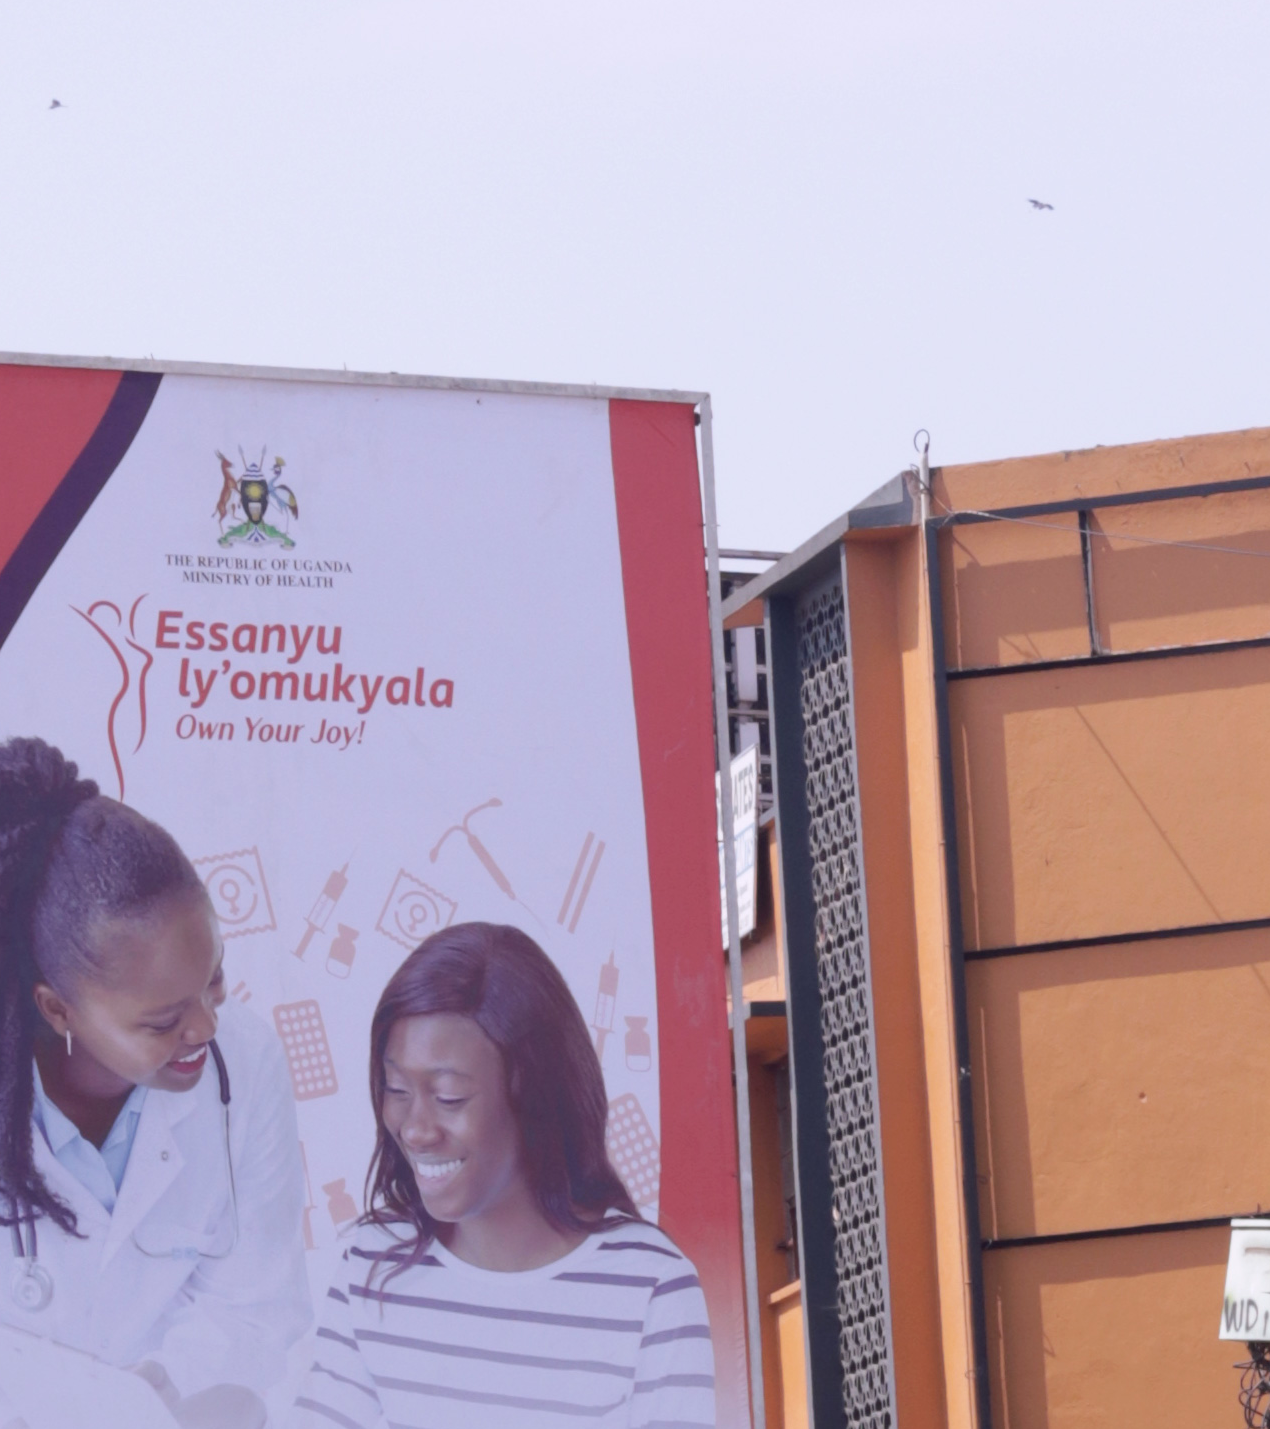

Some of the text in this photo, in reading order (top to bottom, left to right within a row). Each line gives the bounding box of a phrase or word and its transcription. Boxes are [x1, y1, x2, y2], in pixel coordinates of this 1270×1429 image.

[165, 554, 353, 573] THE REPUBLIC OF UGANDA
[182, 571, 334, 589] MINISTRY OF HEALTH
[155, 610, 342, 664] Essanyu
[175, 714, 366, 751] Own Your Joy!
